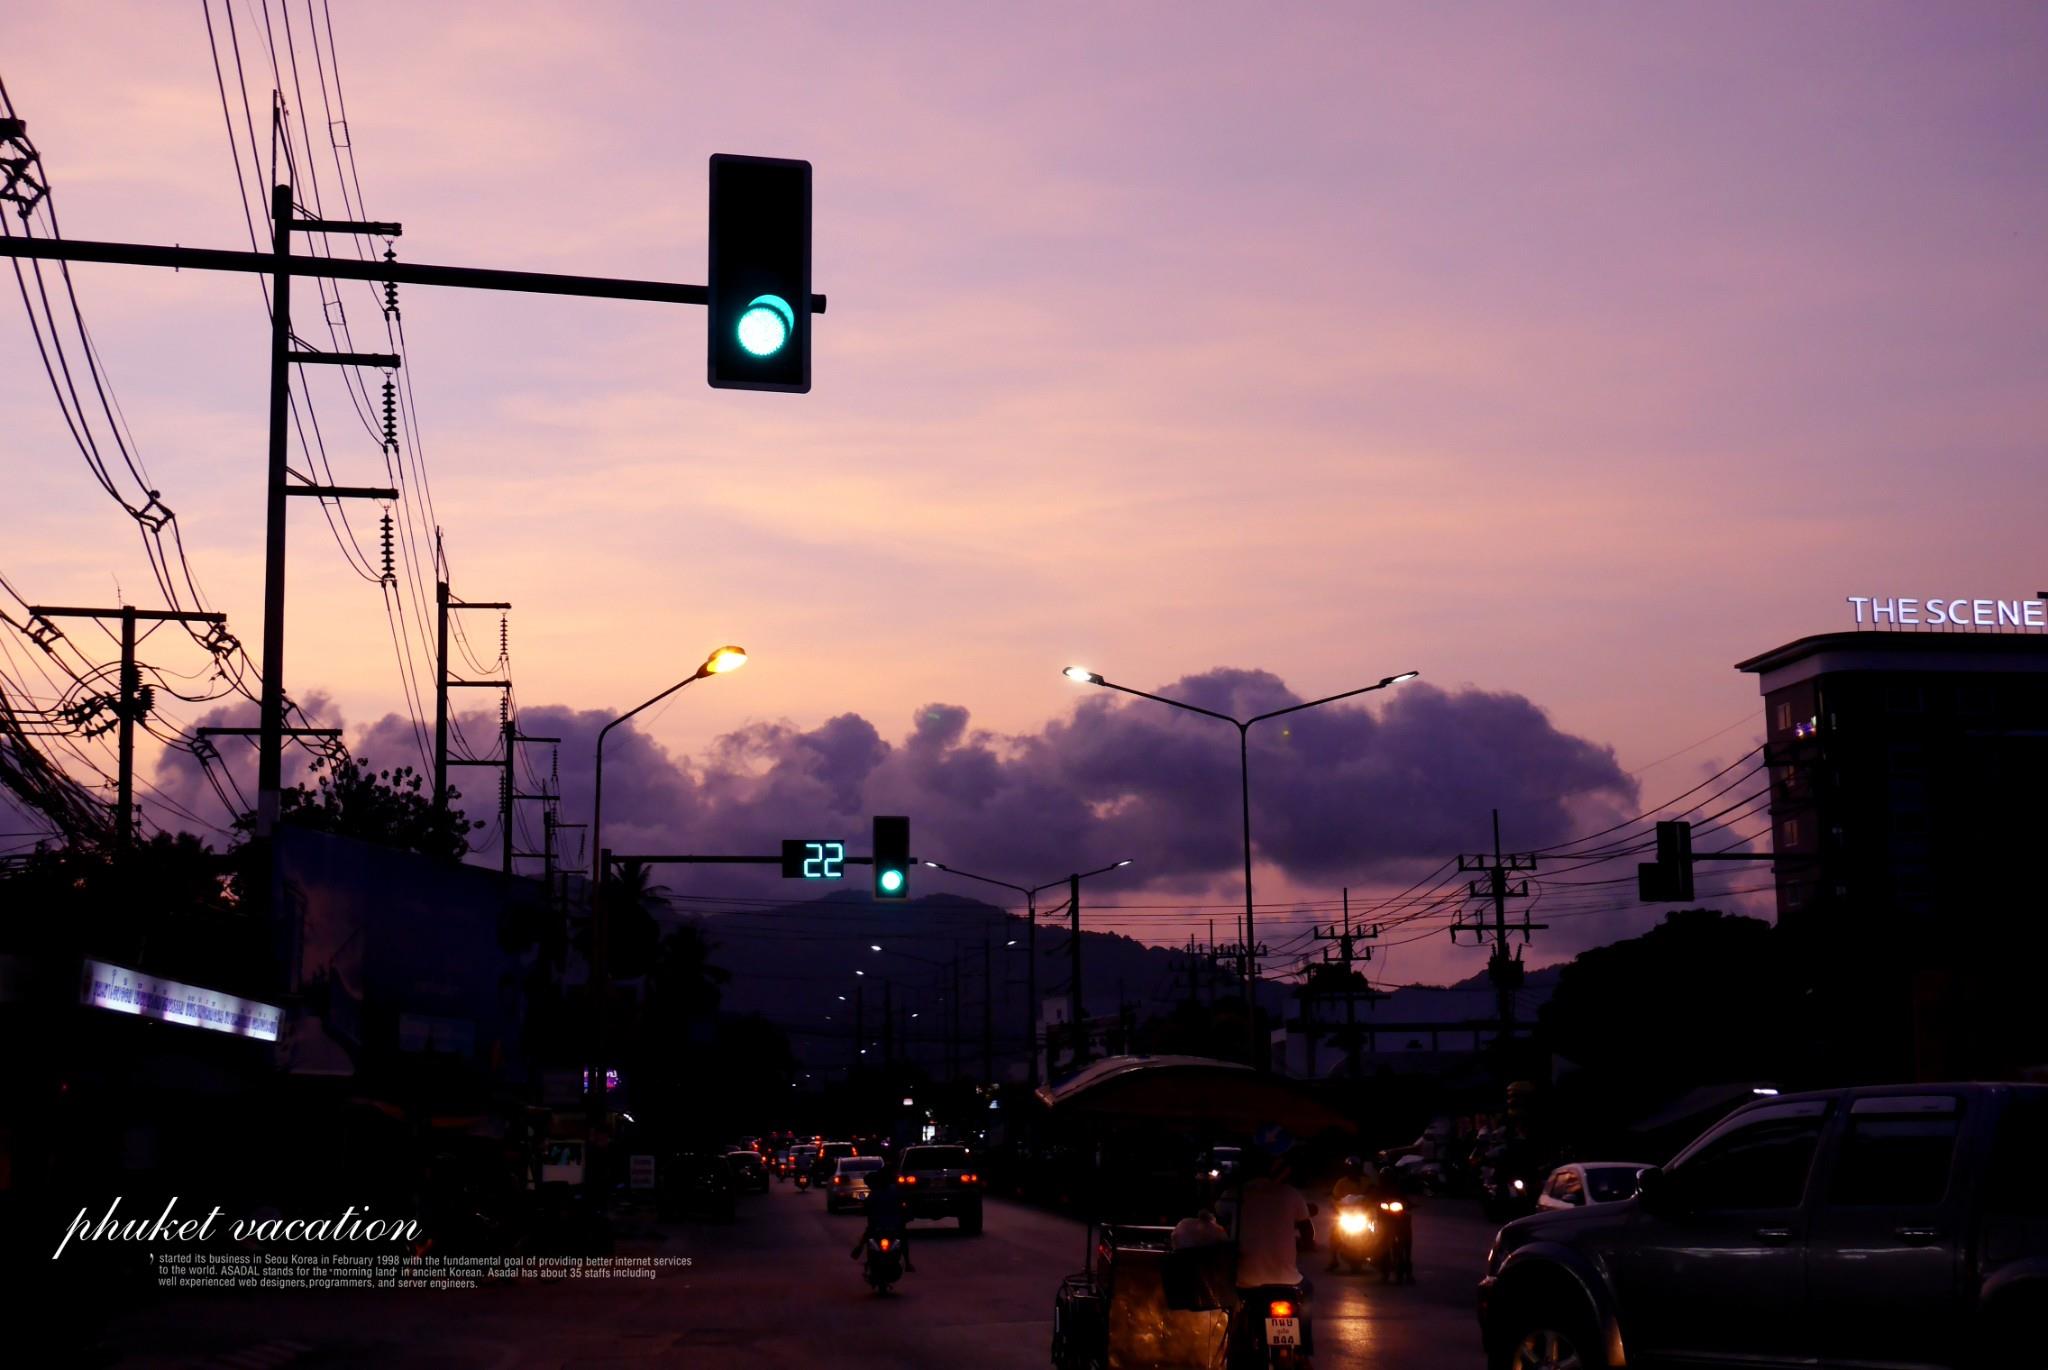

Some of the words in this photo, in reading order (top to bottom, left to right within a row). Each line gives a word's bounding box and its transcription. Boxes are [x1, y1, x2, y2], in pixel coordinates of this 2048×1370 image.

[1847, 596, 1921, 625] THE
[1925, 598, 2044, 627] SCENE
[804, 843, 843, 877] 22
